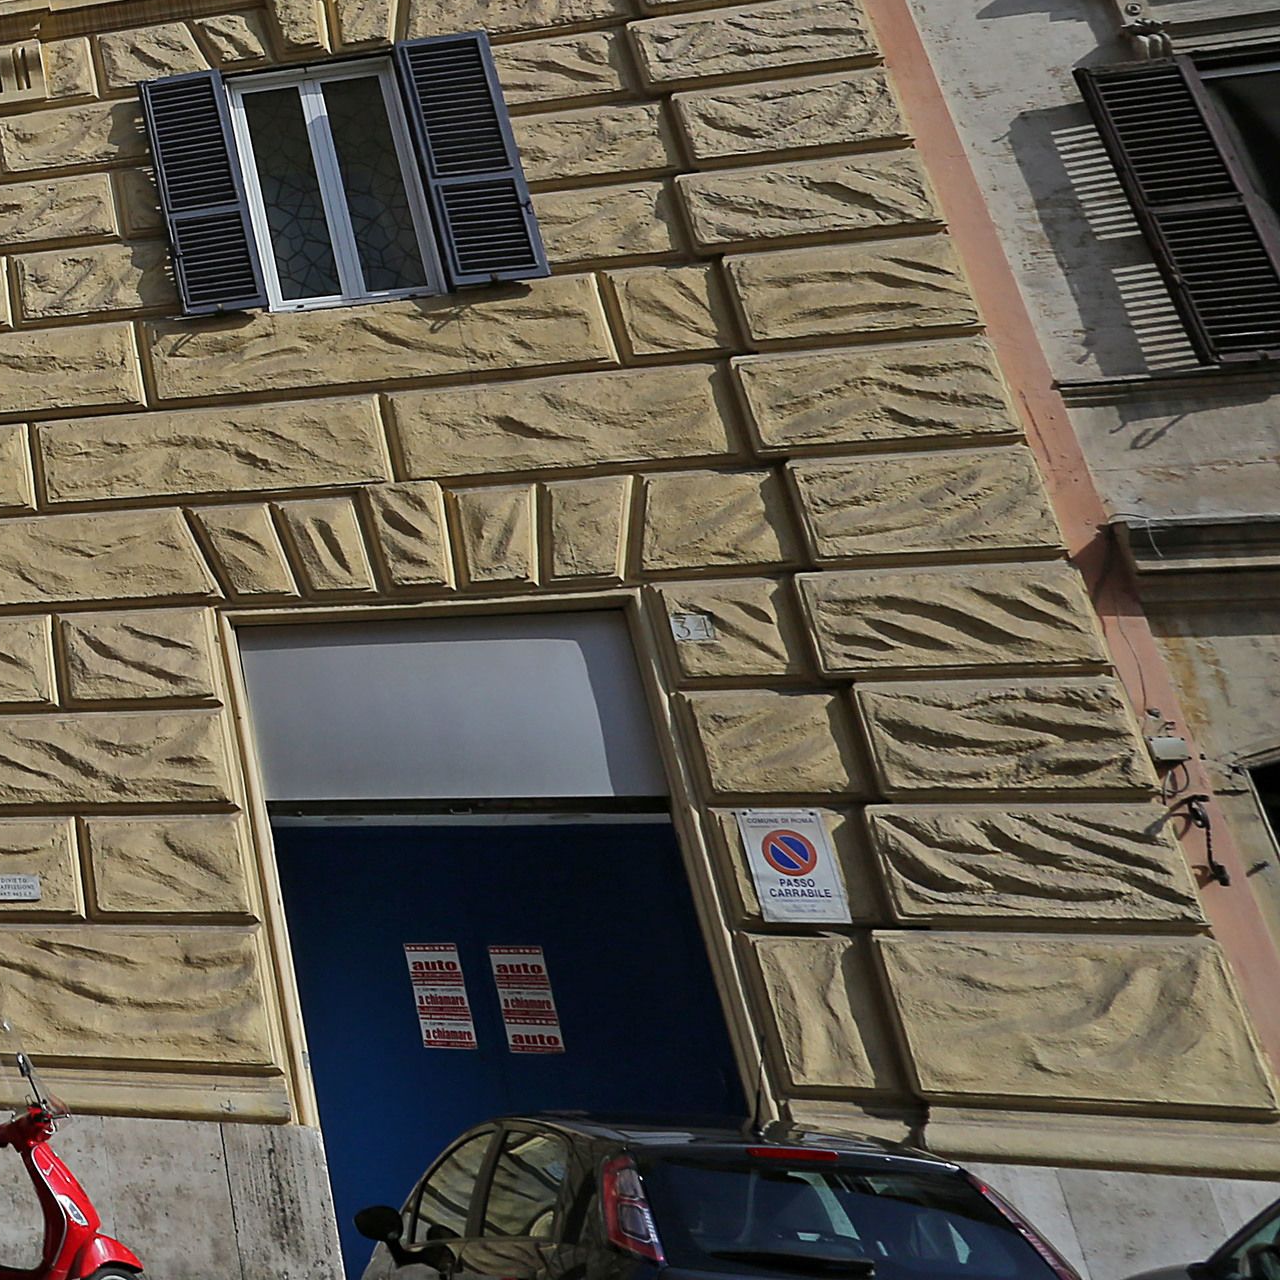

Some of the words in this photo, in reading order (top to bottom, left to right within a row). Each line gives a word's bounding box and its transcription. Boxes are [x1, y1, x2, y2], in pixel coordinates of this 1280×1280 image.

[778, 878, 816, 888] PASSO
[769, 888, 833, 899] CARRABILE
[412, 960, 458, 971] auto
[496, 963, 543, 974] auto
[418, 994, 426, 1005] a
[426, 993, 465, 1006] chiamare
[425, 1028, 433, 1039] a
[433, 1027, 473, 1040] chiamare
[511, 1034, 559, 1045] auto
